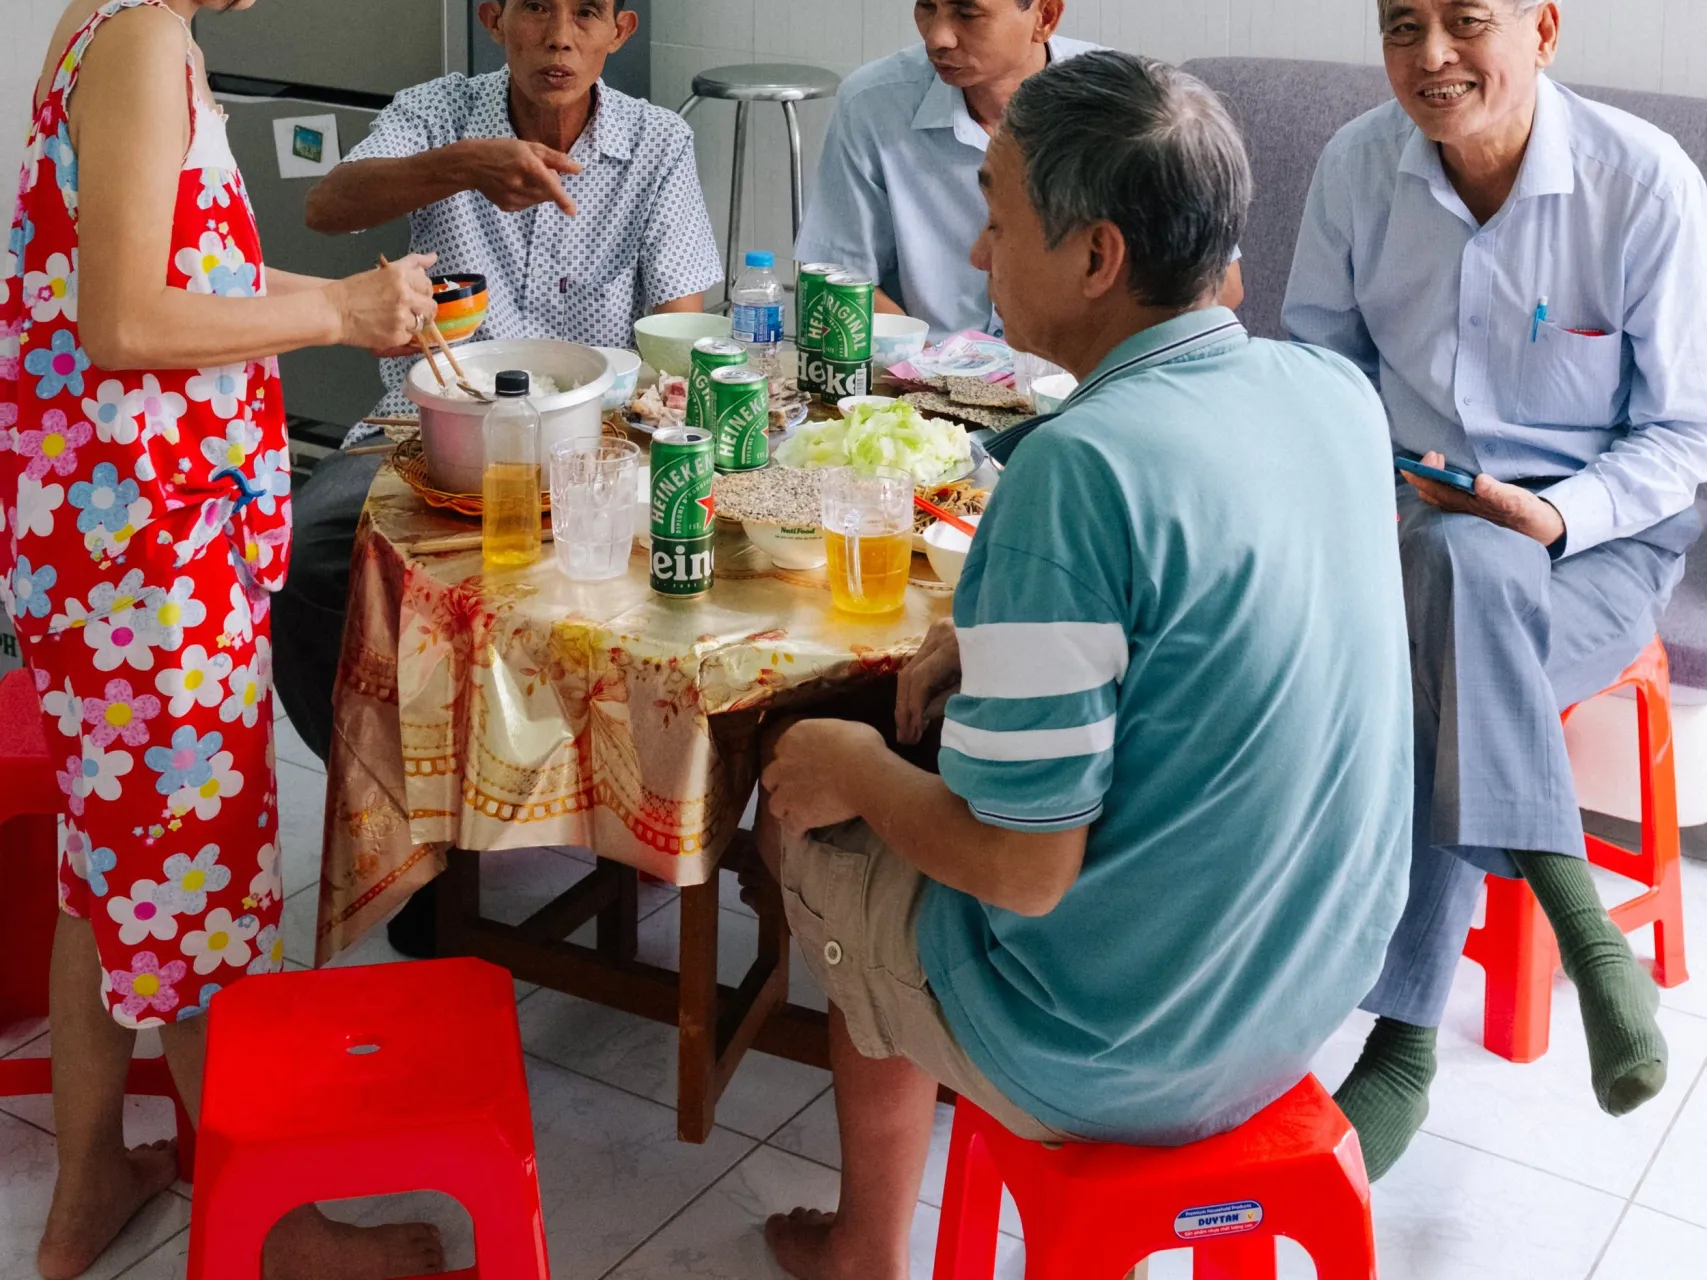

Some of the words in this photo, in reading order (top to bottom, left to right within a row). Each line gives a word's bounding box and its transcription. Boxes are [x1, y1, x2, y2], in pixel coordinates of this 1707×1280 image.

[651, 454, 713, 524] HEINEKEN
[650, 545, 714, 581] ein
[1185, 1209, 1207, 1217] Premium
[1231, 1202, 1252, 1210] Products
[1198, 1214, 1239, 1226] DUYTAN
